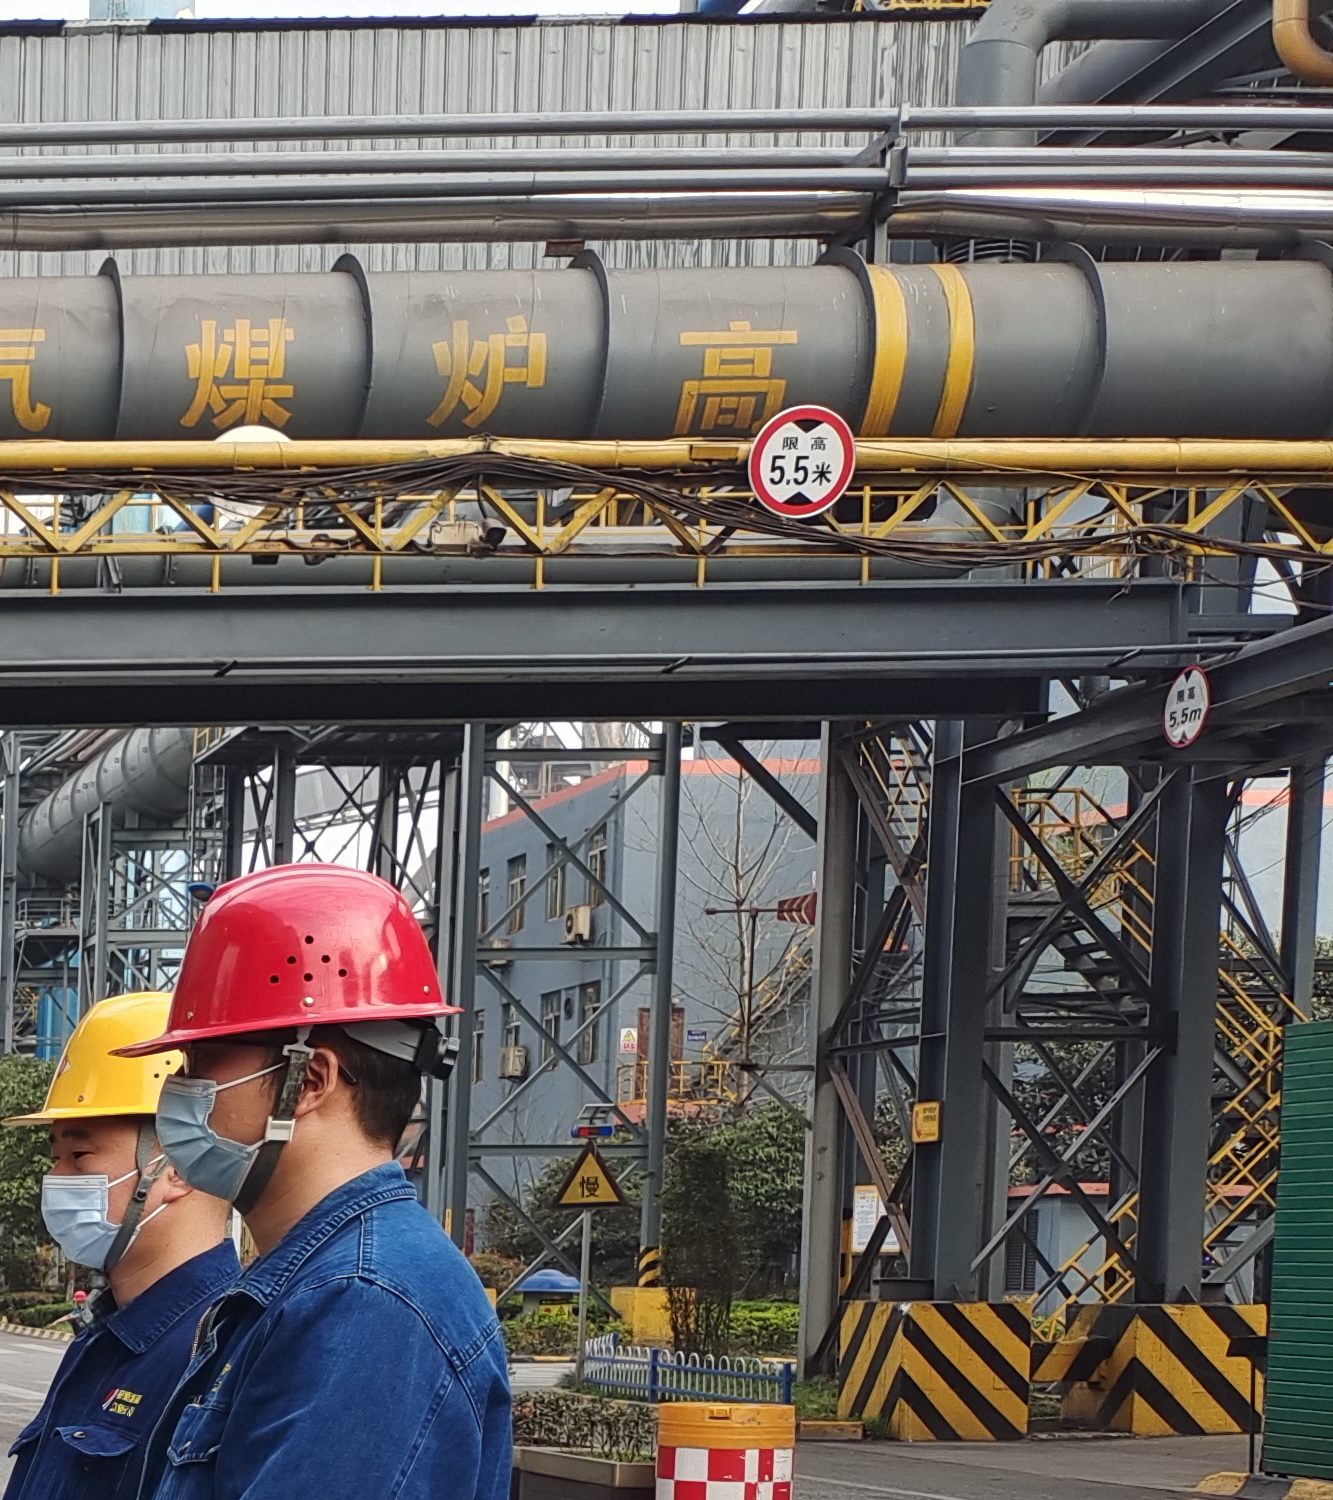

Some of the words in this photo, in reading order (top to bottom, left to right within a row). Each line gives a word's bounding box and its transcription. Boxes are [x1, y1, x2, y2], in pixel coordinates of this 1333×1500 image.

[782, 436, 828, 451] 限高
[769, 455, 833, 486] 5.5米
[1169, 707, 1202, 728] 5.5m
[580, 1175, 600, 1198] 慢
